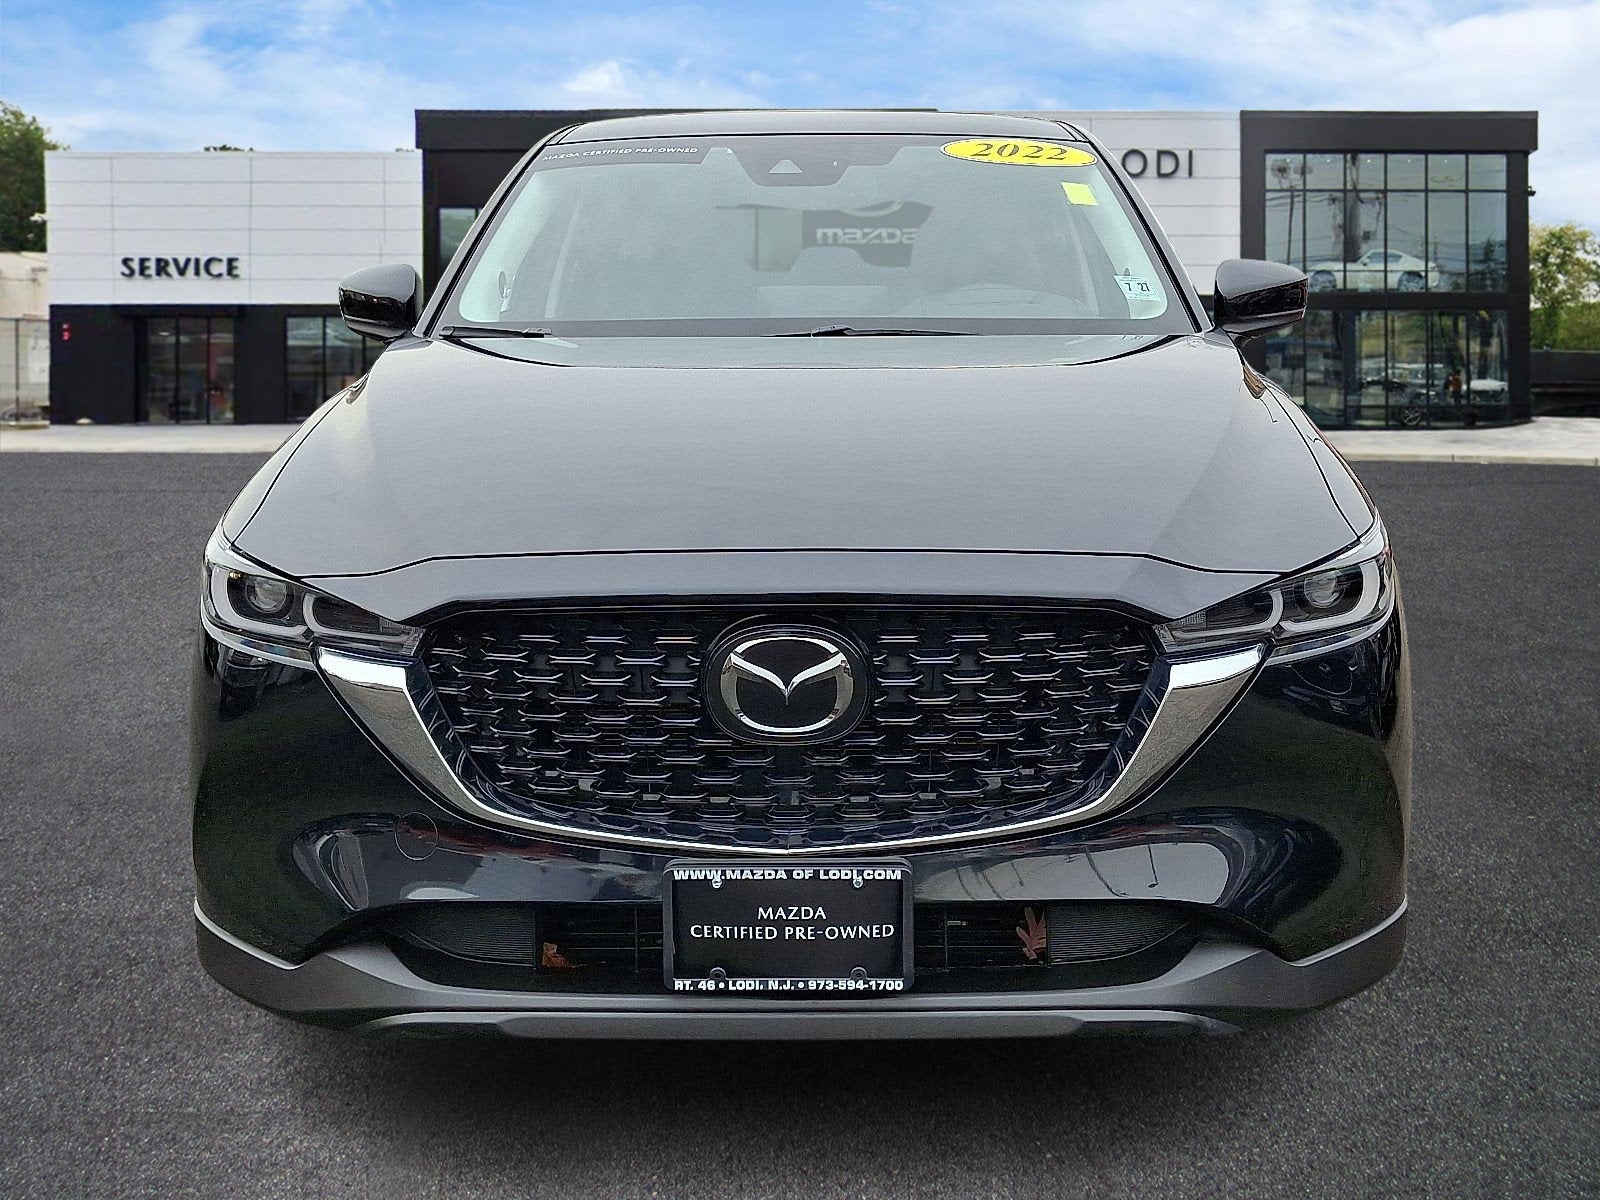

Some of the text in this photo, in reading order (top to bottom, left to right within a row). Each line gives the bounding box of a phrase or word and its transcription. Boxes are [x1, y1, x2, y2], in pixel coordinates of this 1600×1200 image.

[542, 152, 580, 161] MAZDA
[582, 148, 632, 156] CERTIFIED
[970, 142, 1067, 161] 2022
[1121, 148, 1193, 178] ODI
[120, 256, 240, 279] SERVICE
[673, 868, 902, 881] WWW.MAZDA OF LODI.COM
[757, 906, 827, 920] MAZDA
[690, 924, 895, 940] CERTIFIED PRE-OWNED
[674, 980, 694, 991] RT.
[697, 980, 716, 991] 46
[768, 980, 795, 991] N.J.
[808, 980, 904, 991] 973-594-1700
